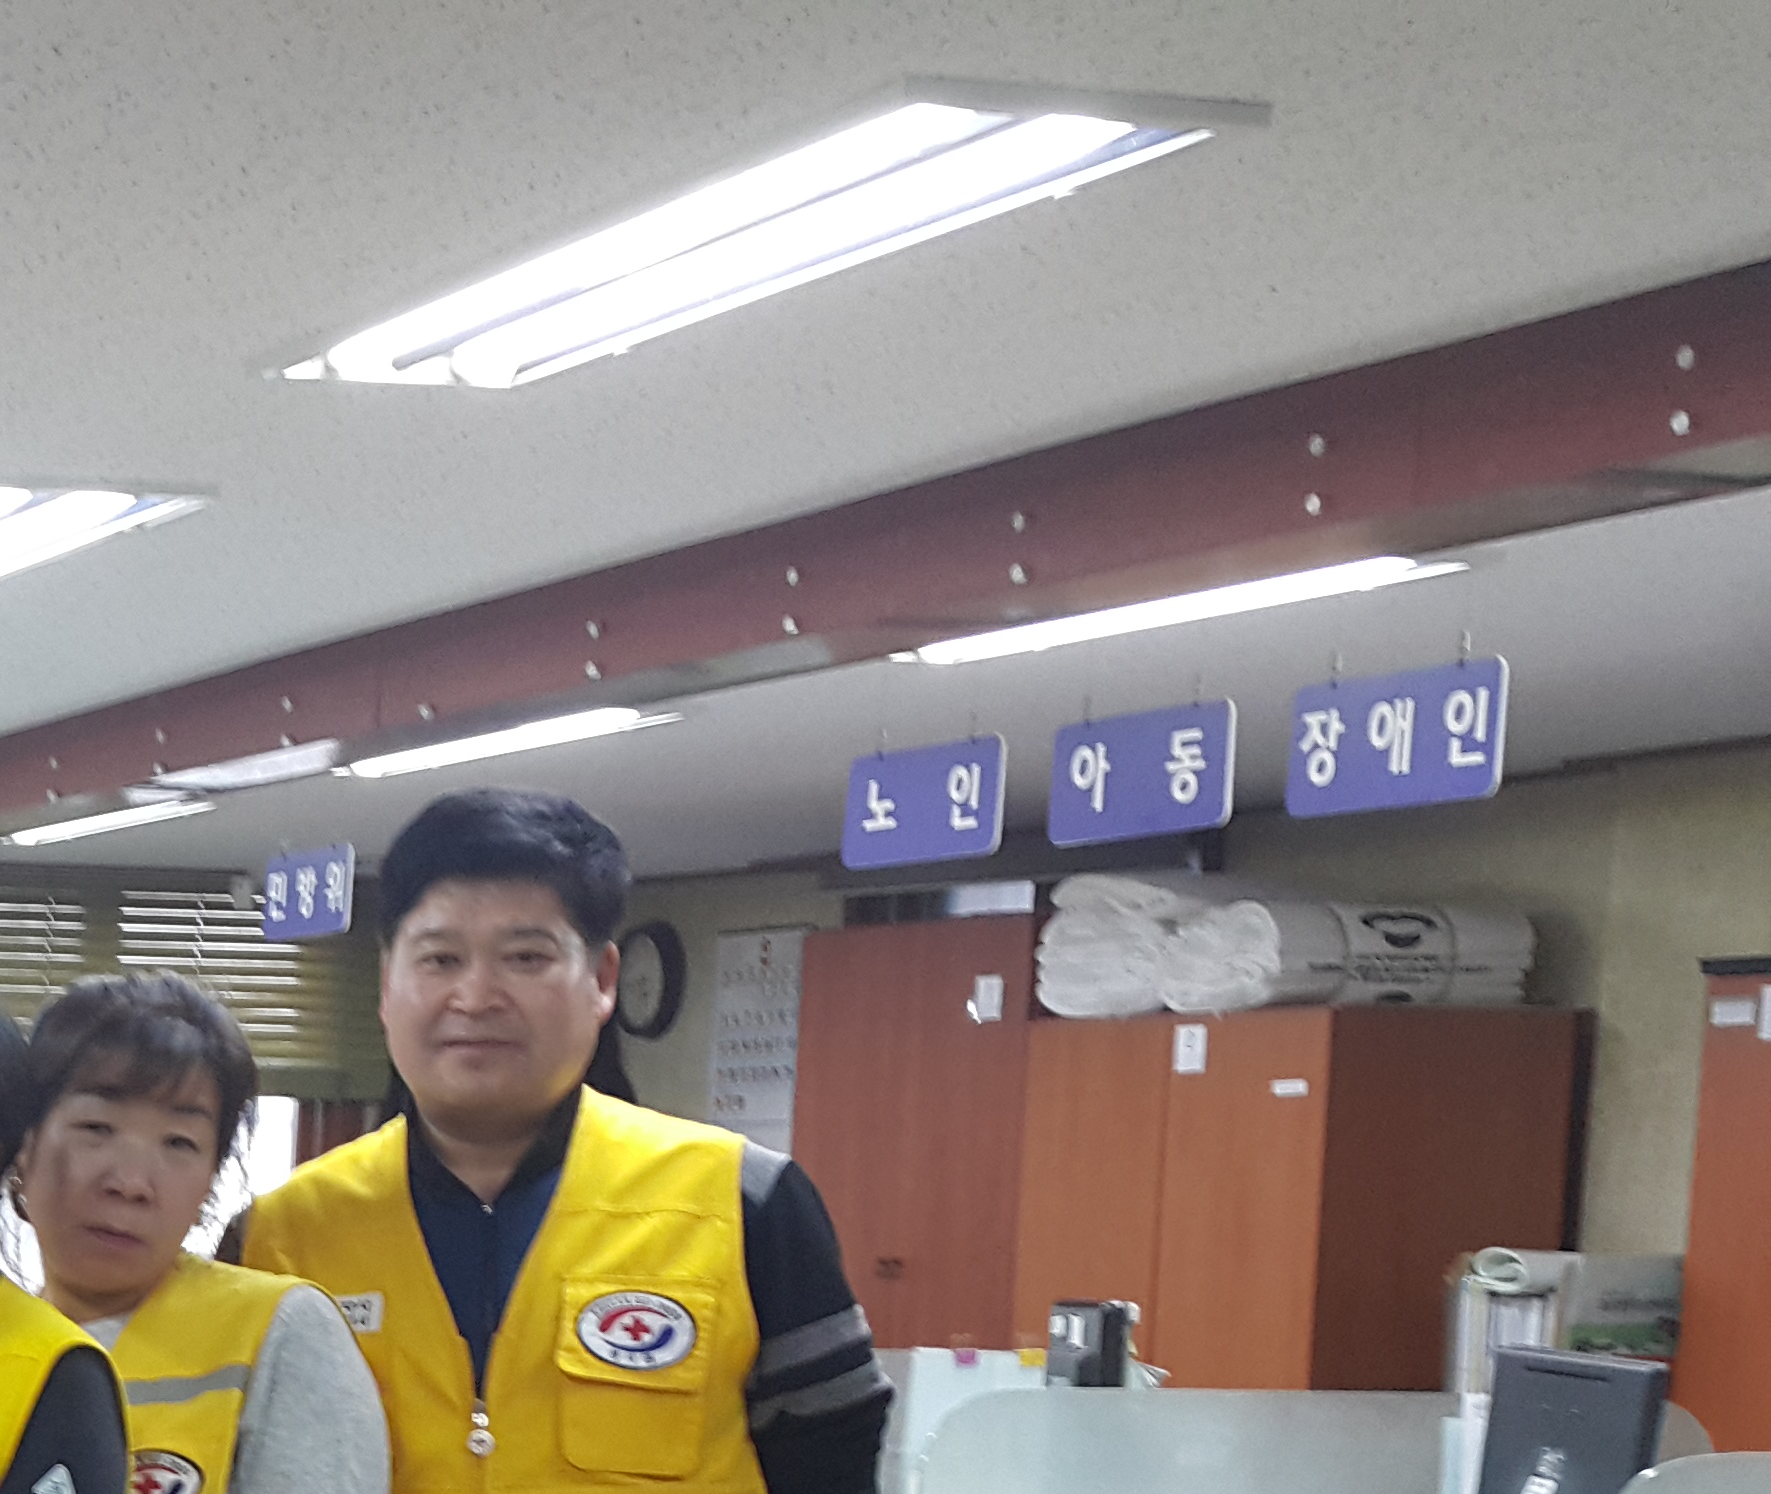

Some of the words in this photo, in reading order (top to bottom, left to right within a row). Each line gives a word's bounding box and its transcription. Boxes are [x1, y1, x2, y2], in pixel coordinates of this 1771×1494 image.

[1069, 727, 1206, 813] 아동
[1298, 686, 1490, 787] 장애인
[861, 761, 982, 832] 노인
